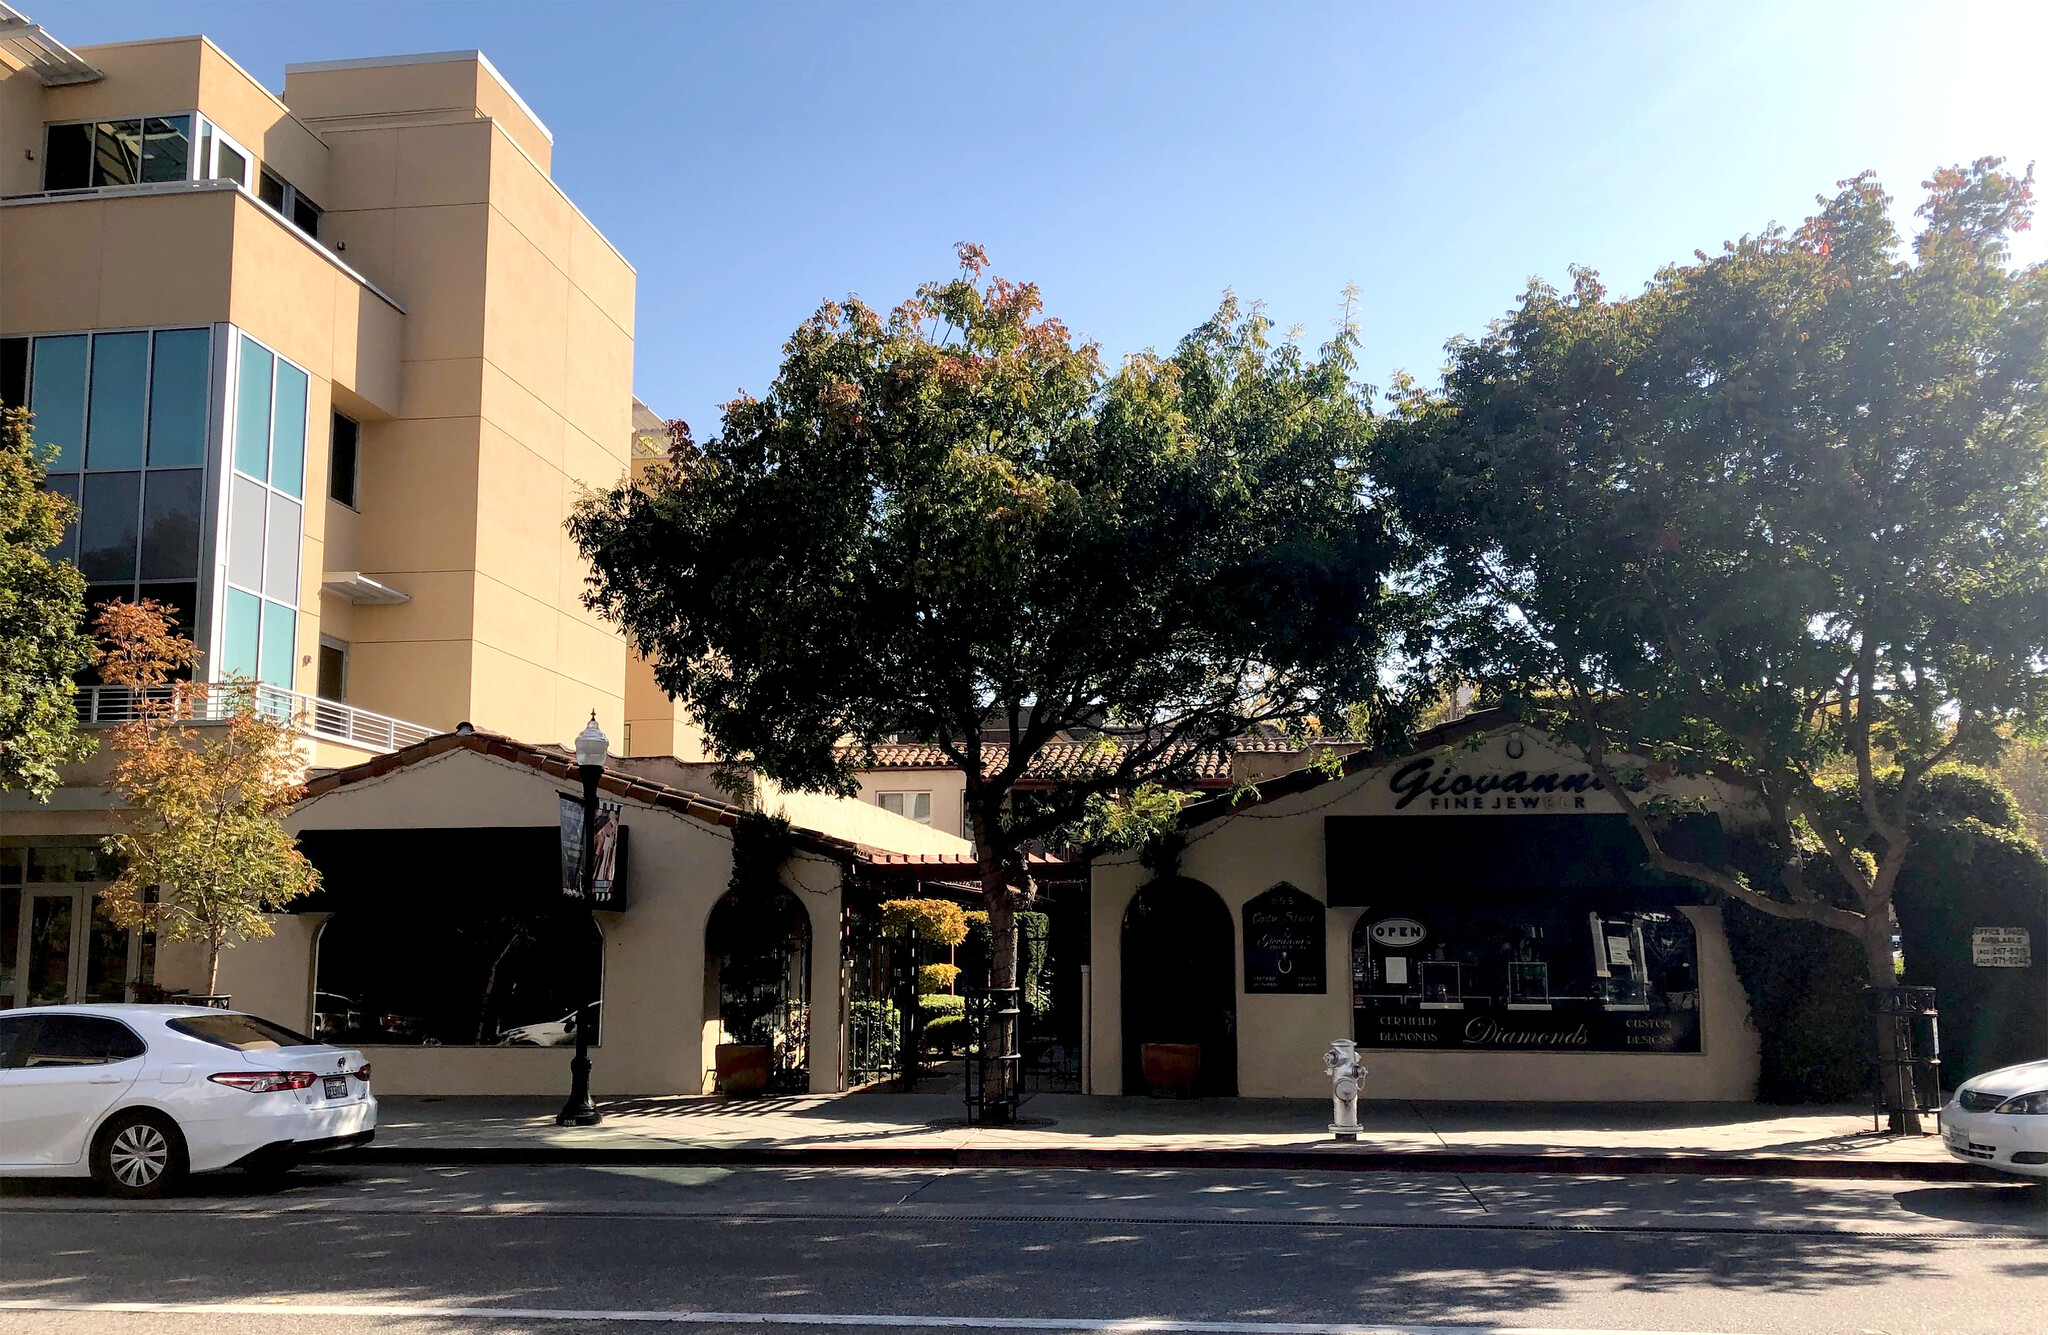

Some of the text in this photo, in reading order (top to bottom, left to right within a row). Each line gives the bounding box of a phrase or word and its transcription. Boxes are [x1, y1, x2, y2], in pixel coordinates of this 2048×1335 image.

[1431, 797, 1483, 809] FINE
[1376, 926, 1421, 937] OPEN
[1379, 1016, 1437, 1026] CERTIFIED
[1626, 1018, 1673, 1029] CUSTOM
[1462, 1016, 1589, 1044] Diamonds
[1379, 1032, 1438, 1042] DIAMONDS
